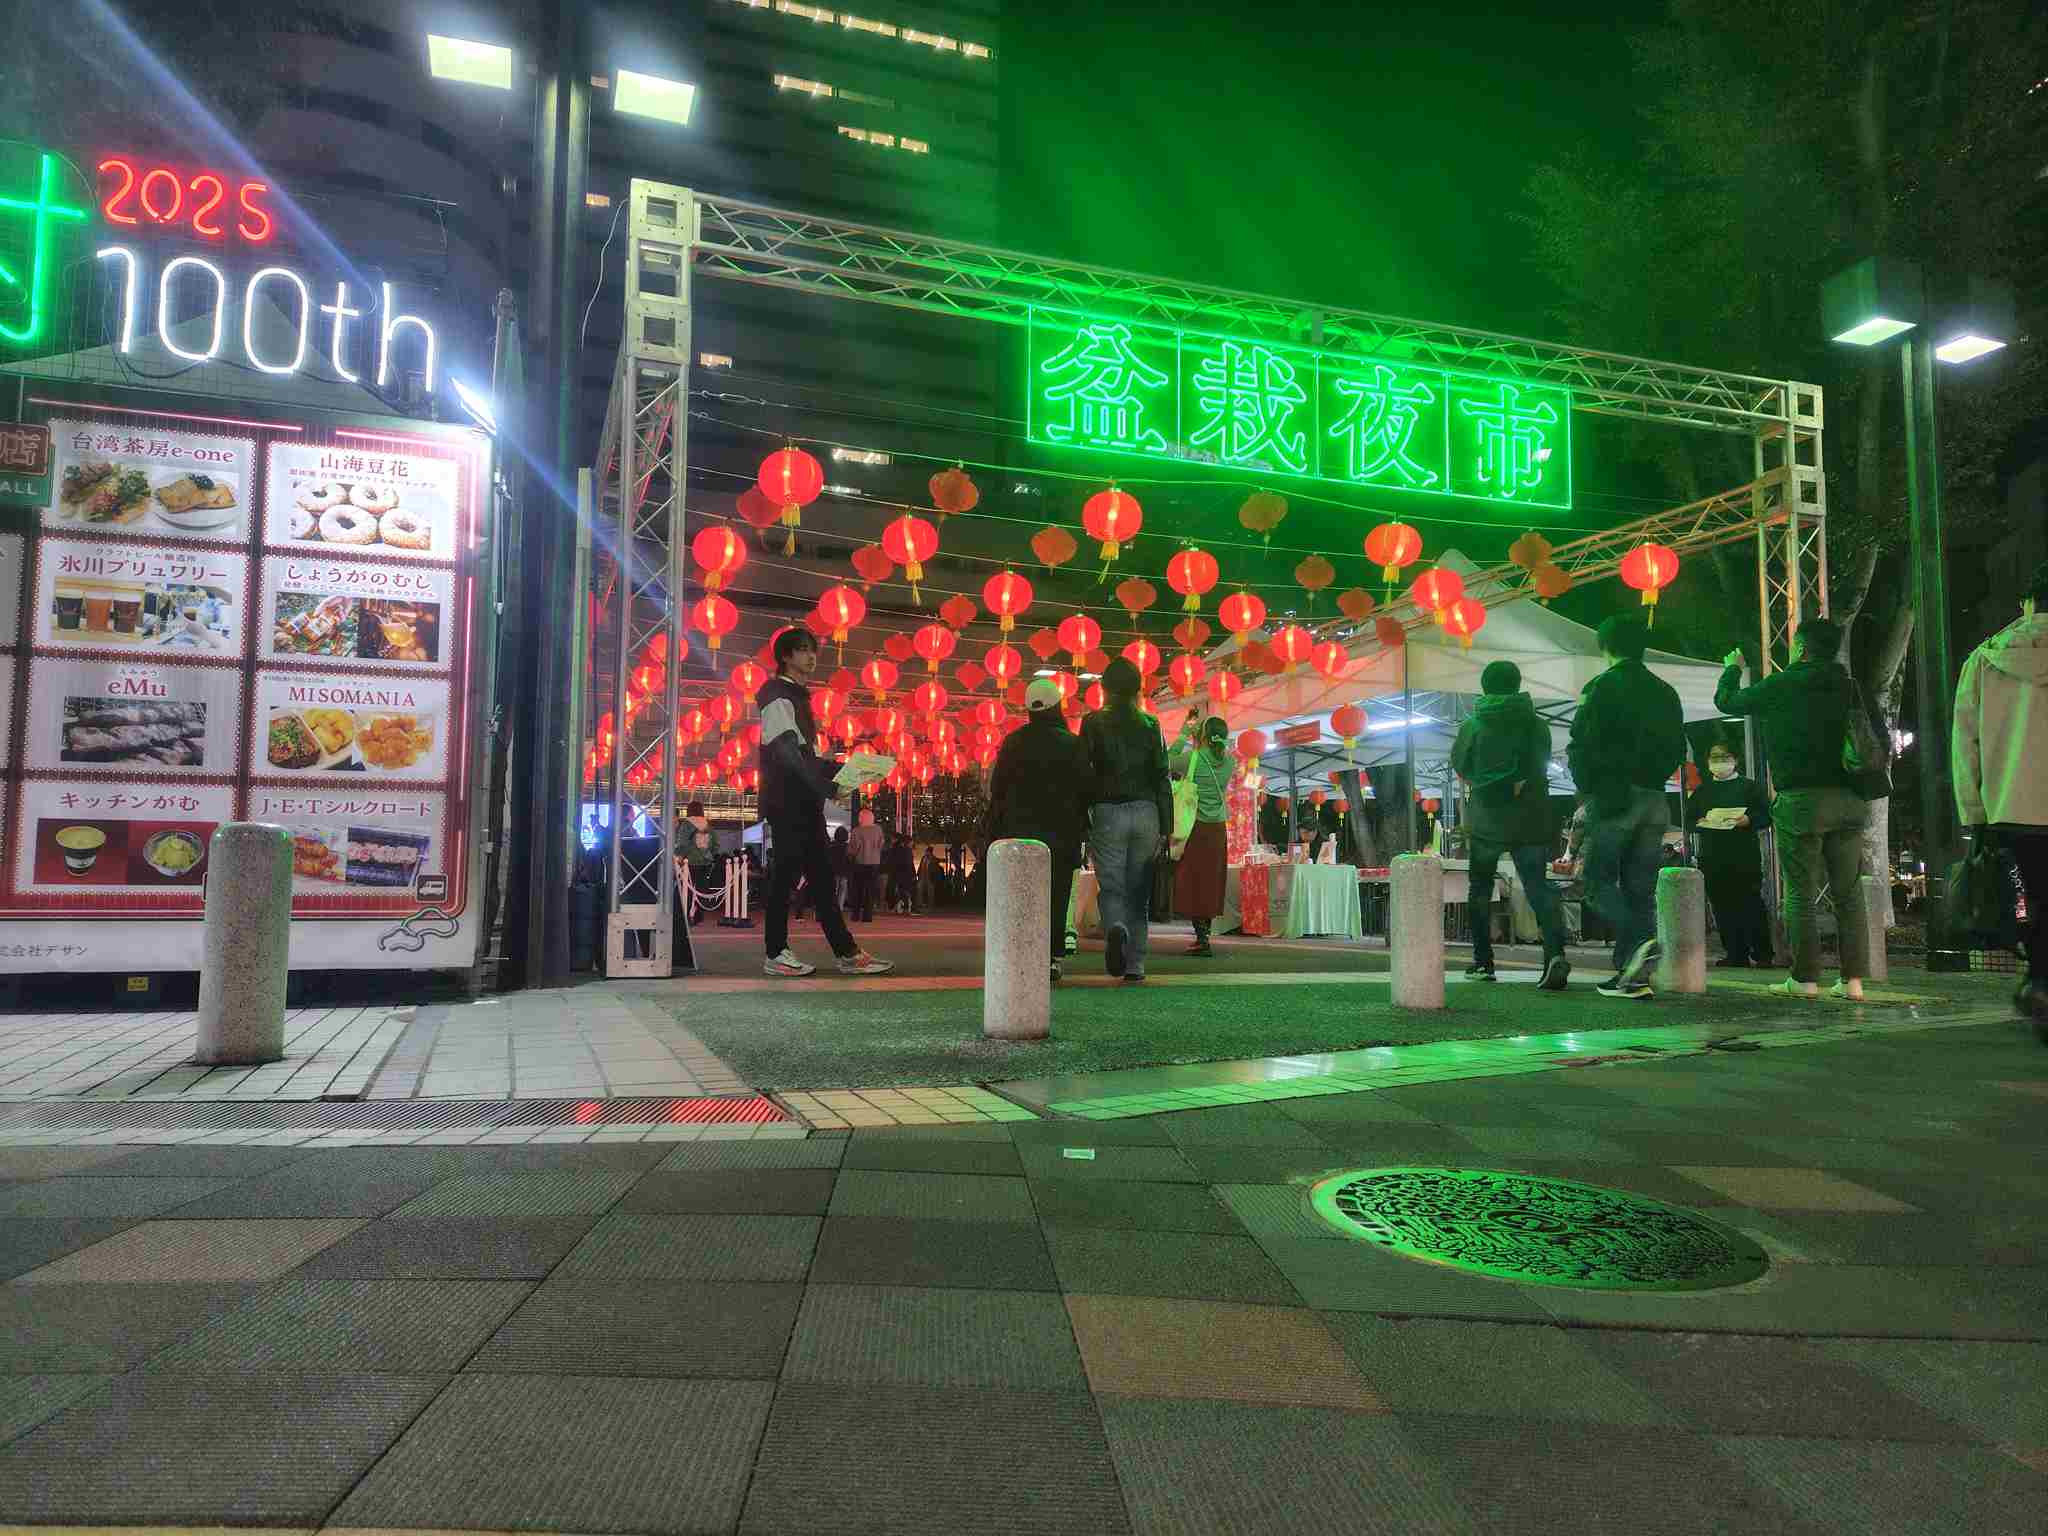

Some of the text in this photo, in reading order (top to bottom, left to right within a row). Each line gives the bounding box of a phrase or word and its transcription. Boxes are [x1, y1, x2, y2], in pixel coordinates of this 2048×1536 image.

[98, 159, 271, 241] 2025
[96, 246, 438, 393] 100th
[1041, 322, 1558, 498] 盆栽夜市
[320, 453, 409, 477] 山海豆花
[58, 554, 228, 581] 氷川ブリュワリー
[287, 564, 431, 590] しょうがのむし
[107, 677, 168, 697] eMu
[288, 686, 416, 707] MISOMANIA
[58, 791, 200, 812] キッチンがむ
